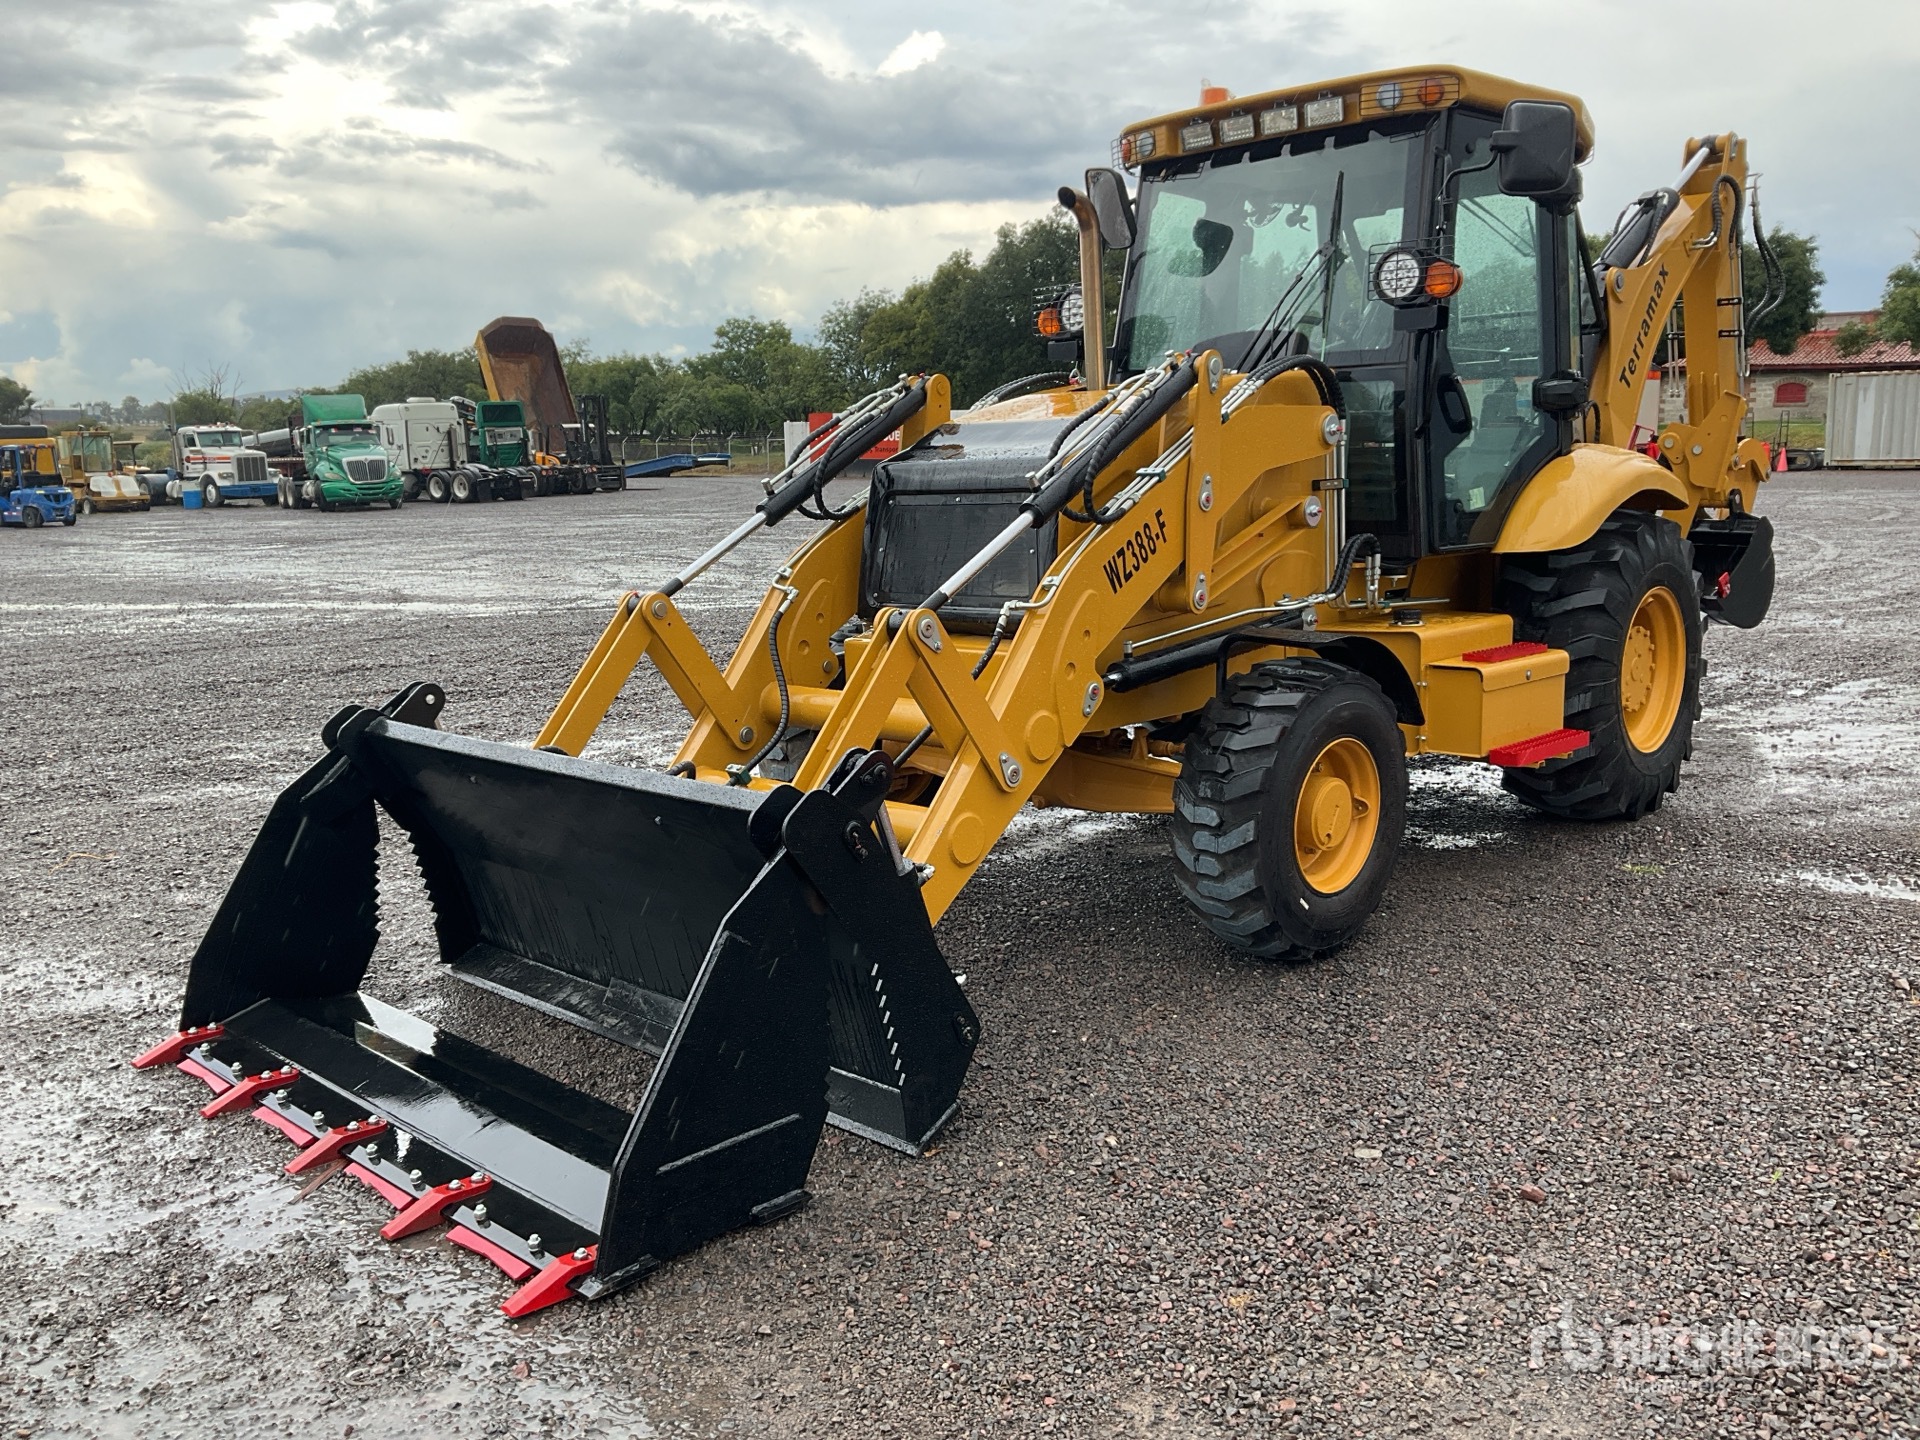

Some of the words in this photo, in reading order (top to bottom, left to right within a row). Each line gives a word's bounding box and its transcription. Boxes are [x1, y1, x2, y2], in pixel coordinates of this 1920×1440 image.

[1619, 263, 1669, 389] Terramax
[875, 446, 898, 454] Transpor
[1102, 508, 1167, 594] WZ388-F
